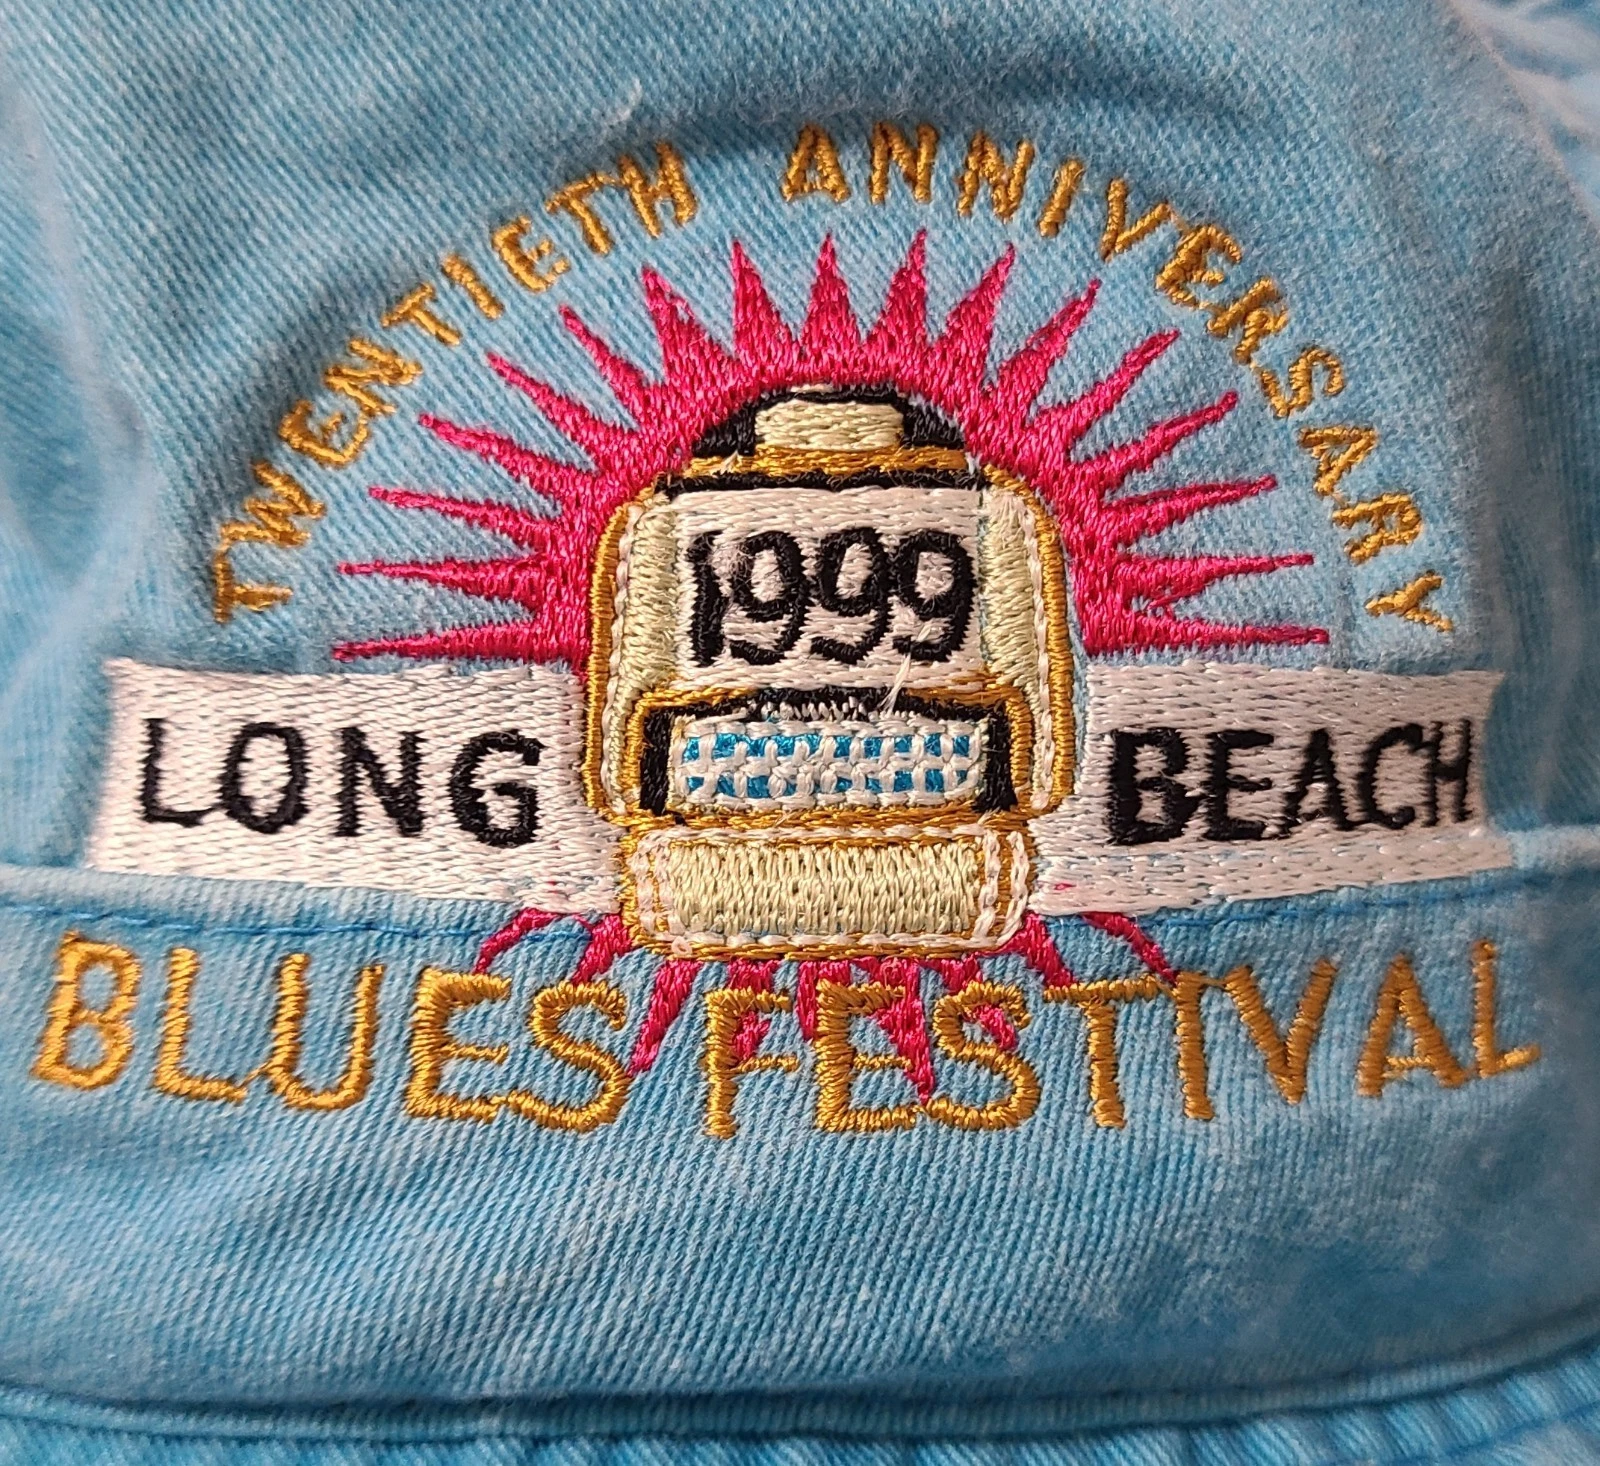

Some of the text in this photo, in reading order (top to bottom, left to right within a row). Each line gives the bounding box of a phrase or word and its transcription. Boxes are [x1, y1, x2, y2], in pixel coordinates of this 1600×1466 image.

[210, 120, 1453, 633] TWENTIETH ANNIVERSARY
[686, 526, 977, 667] 1999
[137, 717, 1475, 847] LONG BEACH
[30, 930, 1543, 1140] BLUES FESTIVAL
